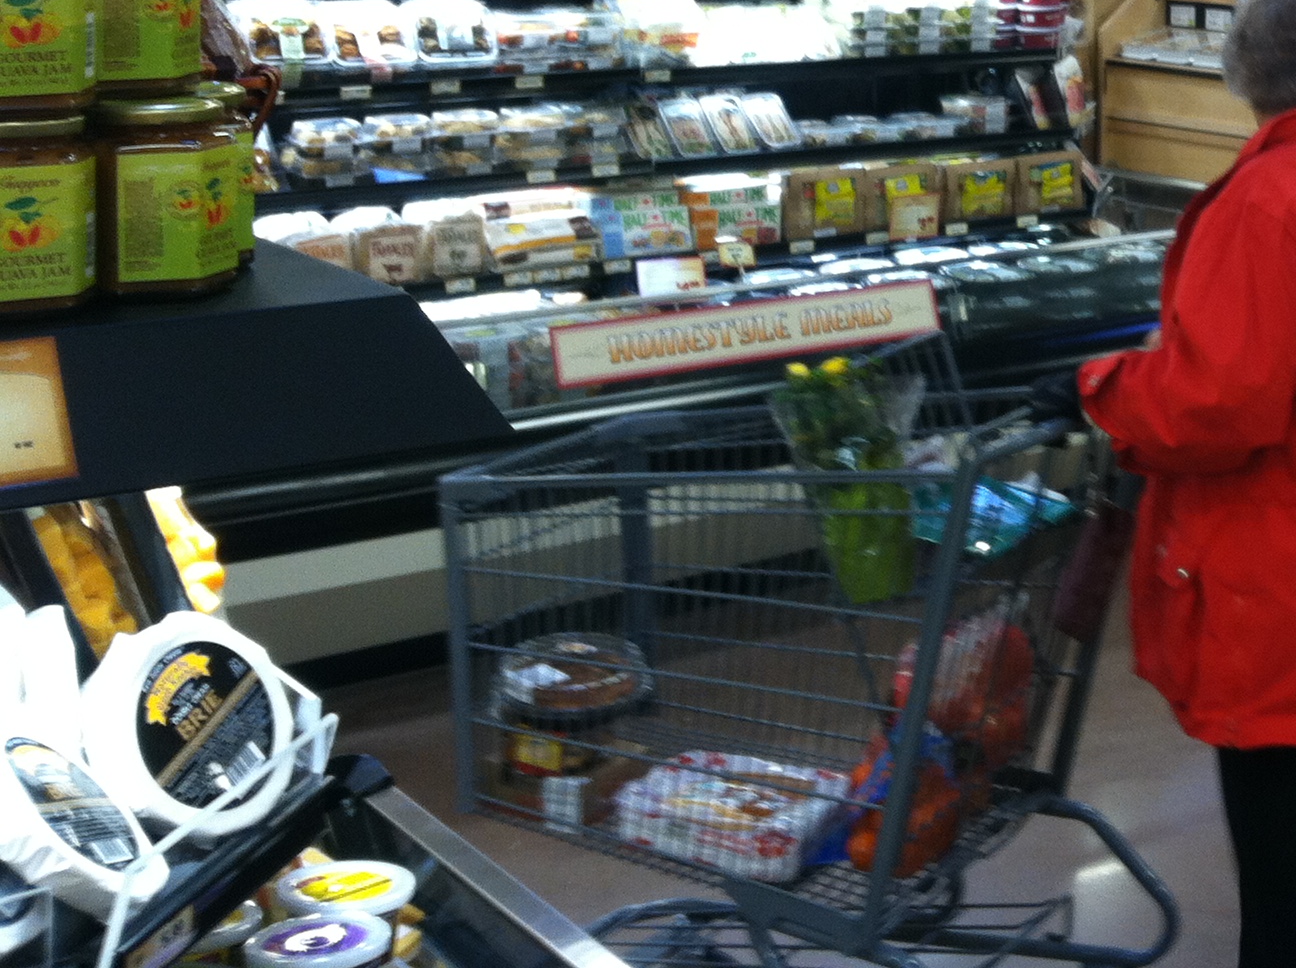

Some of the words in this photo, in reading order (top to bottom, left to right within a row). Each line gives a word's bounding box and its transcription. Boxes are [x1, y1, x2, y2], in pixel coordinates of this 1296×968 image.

[0, 50, 67, 63] OURMET
[0, 64, 39, 77] UAVA
[0, 253, 67, 267] OURMET
[0, 268, 38, 280] UAVA
[608, 311, 791, 363] HOMESTYLE
[800, 298, 893, 336] MEALS
[175, 689, 224, 741] BRIE
